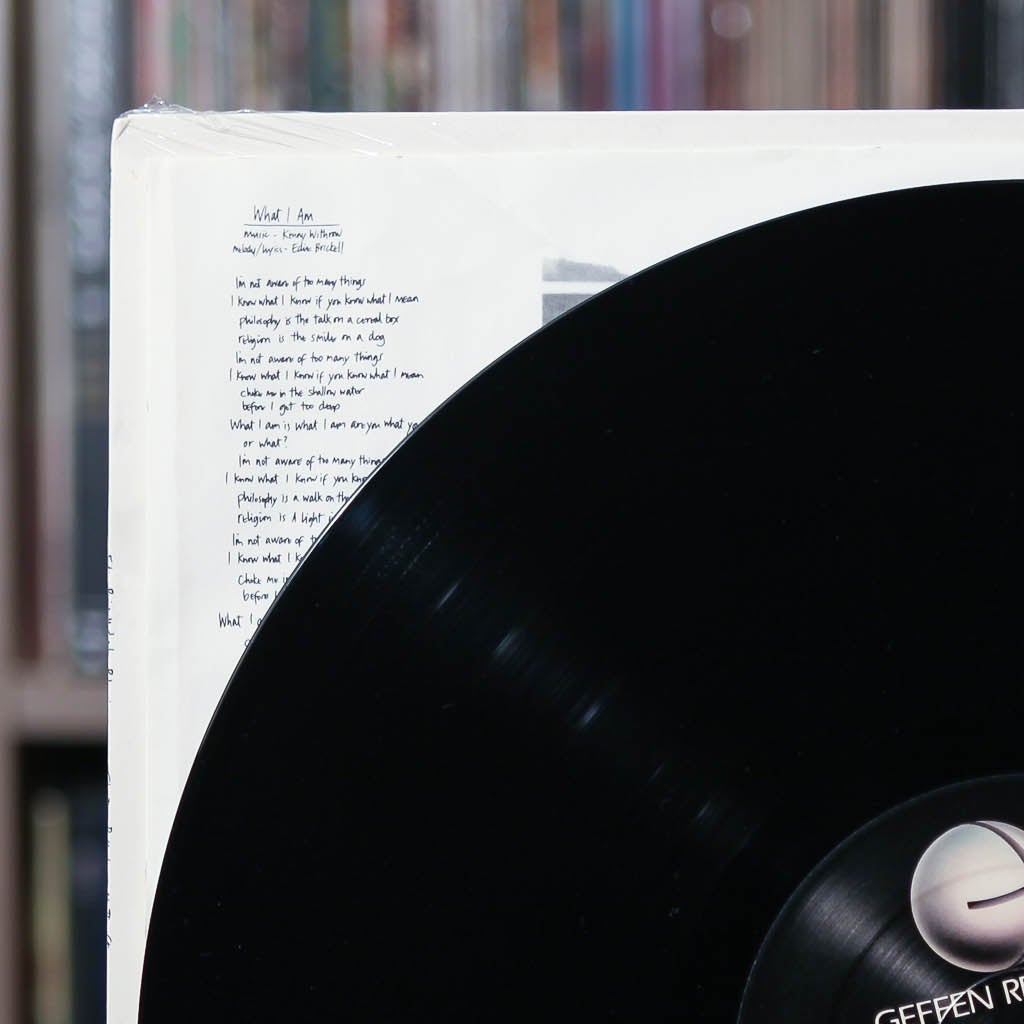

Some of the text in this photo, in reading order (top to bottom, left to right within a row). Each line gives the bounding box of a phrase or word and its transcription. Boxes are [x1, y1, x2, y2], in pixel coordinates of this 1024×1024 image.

[254, 207, 313, 224] What I Am
[240, 315, 280, 330] philosophy
[314, 314, 331, 324] talk
[386, 314, 399, 325] box
